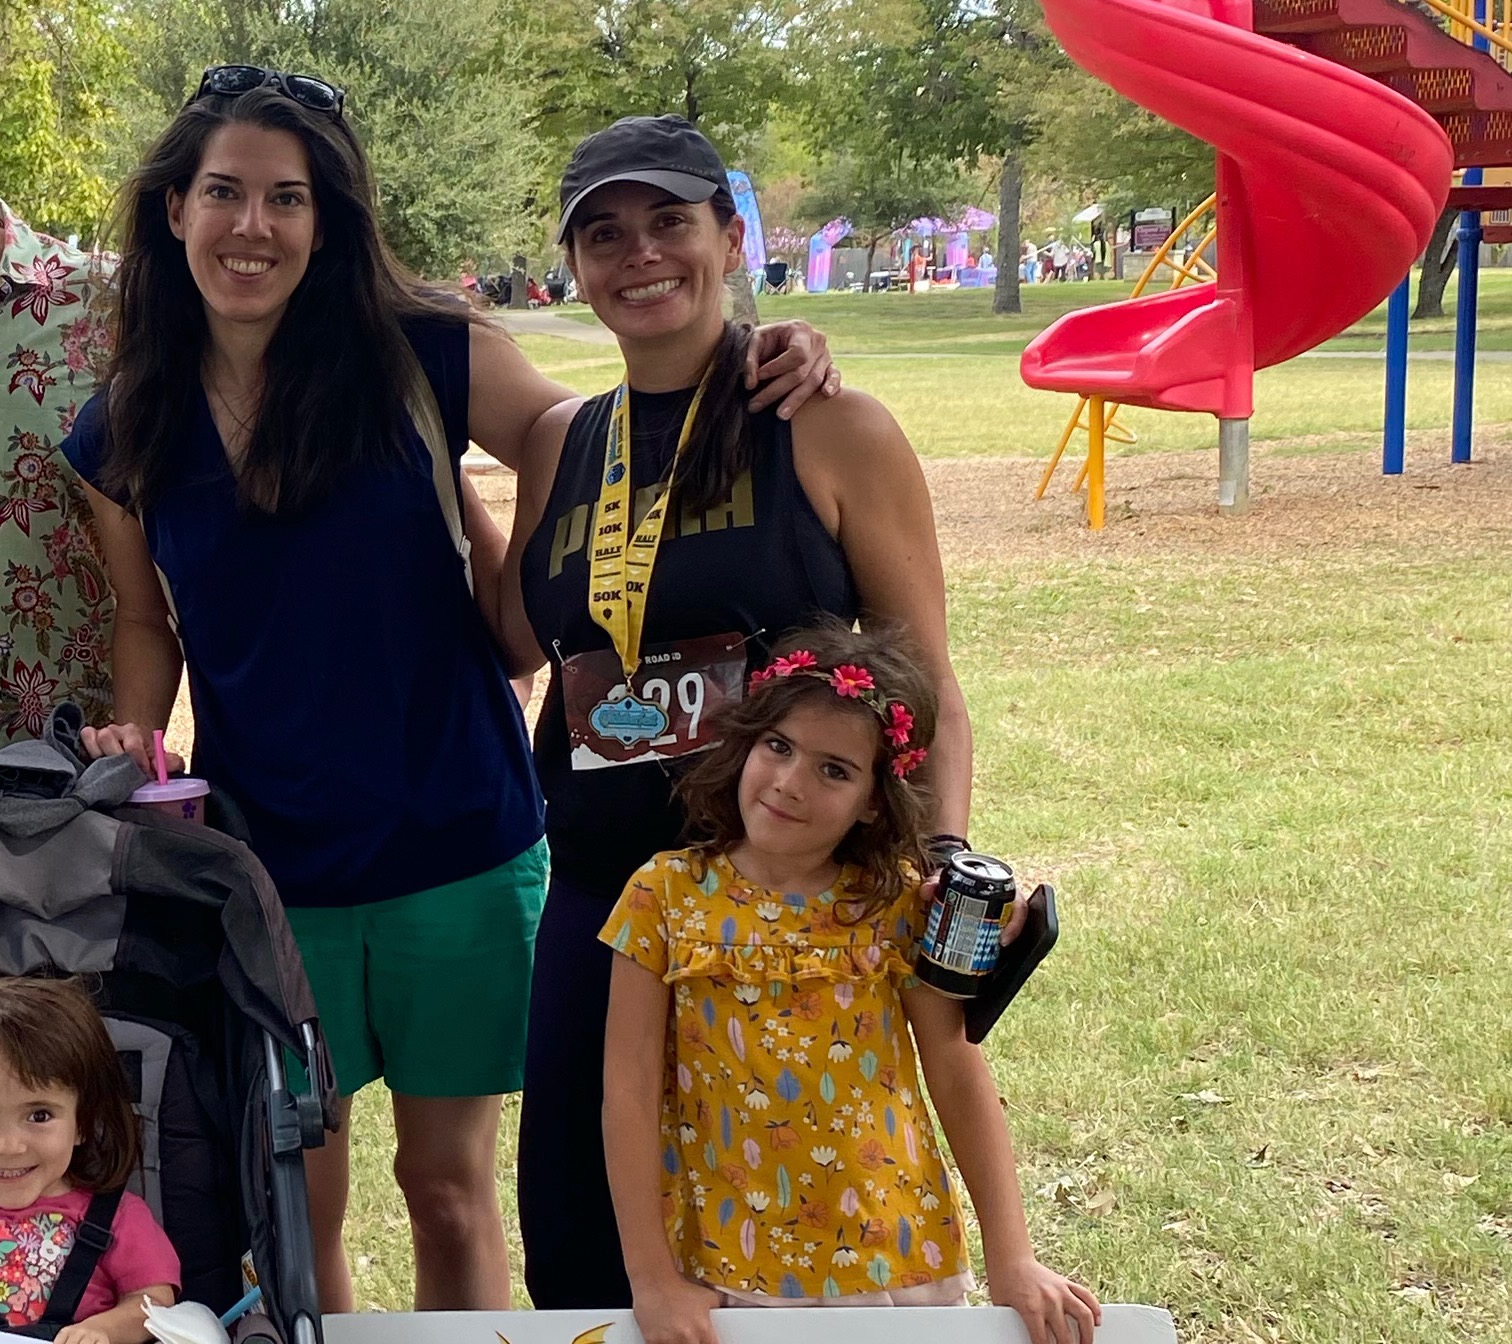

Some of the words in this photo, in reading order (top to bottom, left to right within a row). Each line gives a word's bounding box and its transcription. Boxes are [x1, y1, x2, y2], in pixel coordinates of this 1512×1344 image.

[604, 500, 621, 513] 5K
[598, 522, 622, 536] 10K
[595, 545, 622, 557] HALF
[626, 580, 645, 593] 0K
[593, 590, 622, 602] 50K
[644, 653, 670, 665] ROAD
